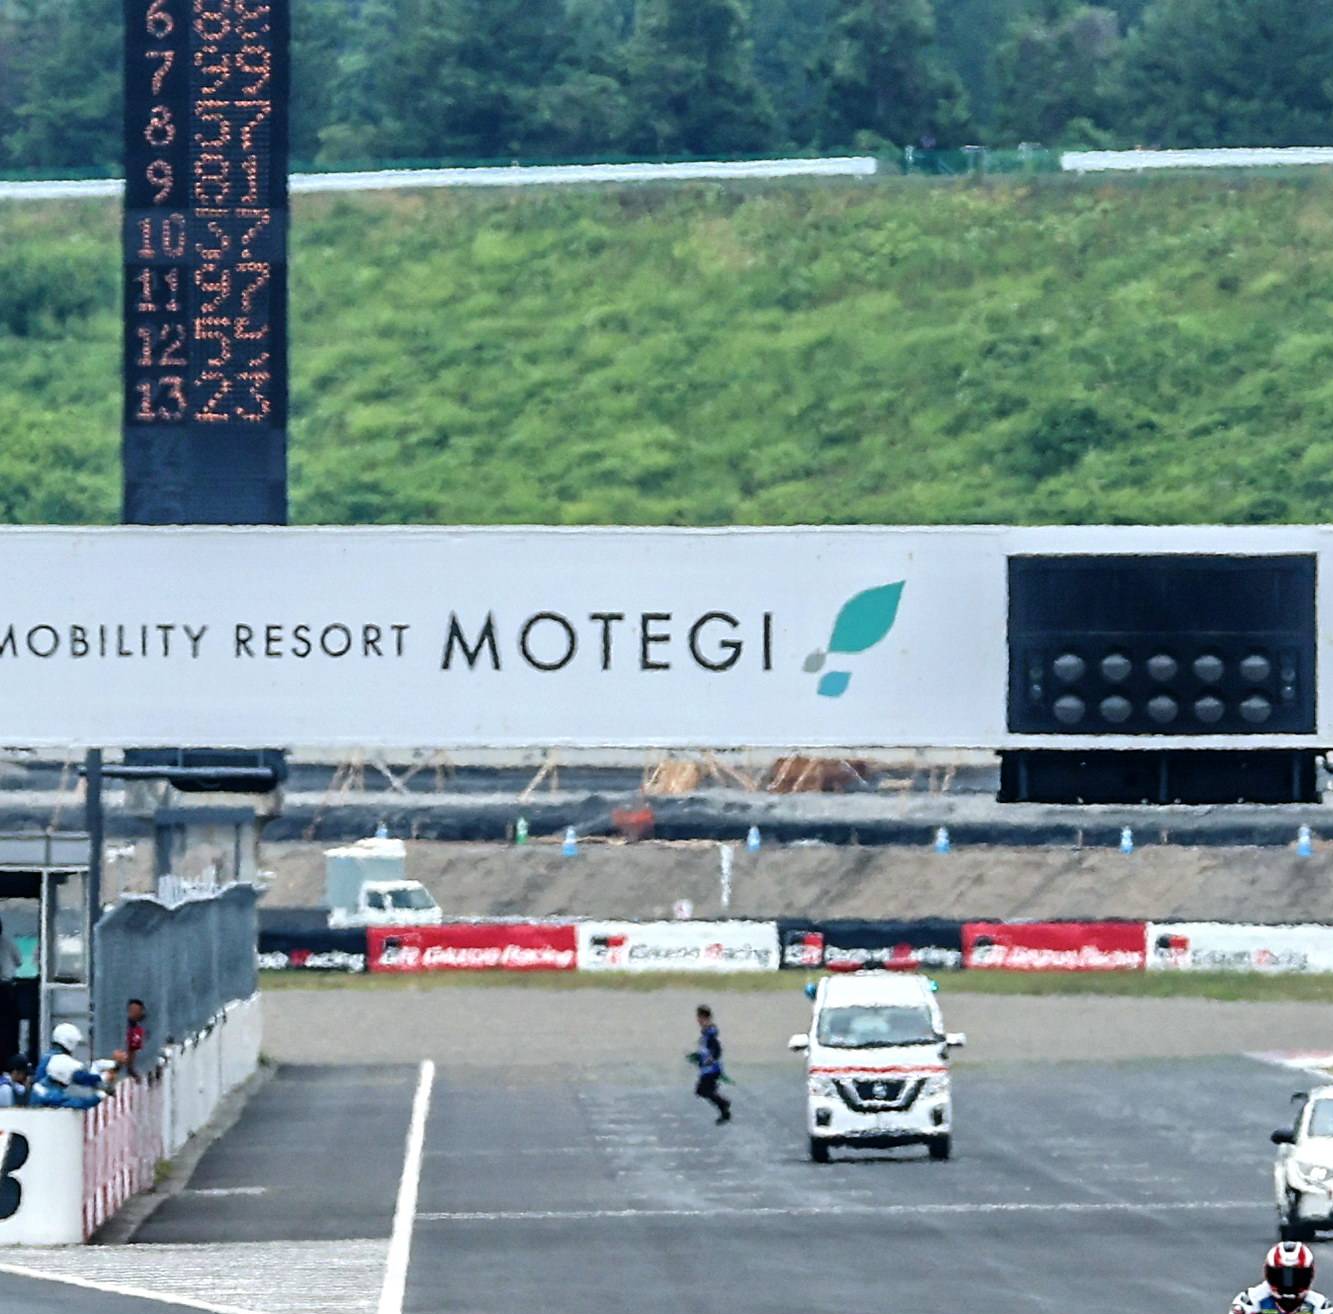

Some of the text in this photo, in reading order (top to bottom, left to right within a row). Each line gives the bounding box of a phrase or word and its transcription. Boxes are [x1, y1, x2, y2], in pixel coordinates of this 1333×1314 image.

[147, 0, 174, 39] 6
[145, 51, 175, 95] 7
[145, 101, 271, 149] 8 57
[147, 153, 257, 204] 9 81
[138, 213, 186, 258] 10
[133, 263, 270, 313] 11 97
[137, 324, 188, 366] 12
[137, 371, 271, 421] 13 23
[235, 623, 410, 659] RESORT
[441, 611, 774, 672] MOTEGI
